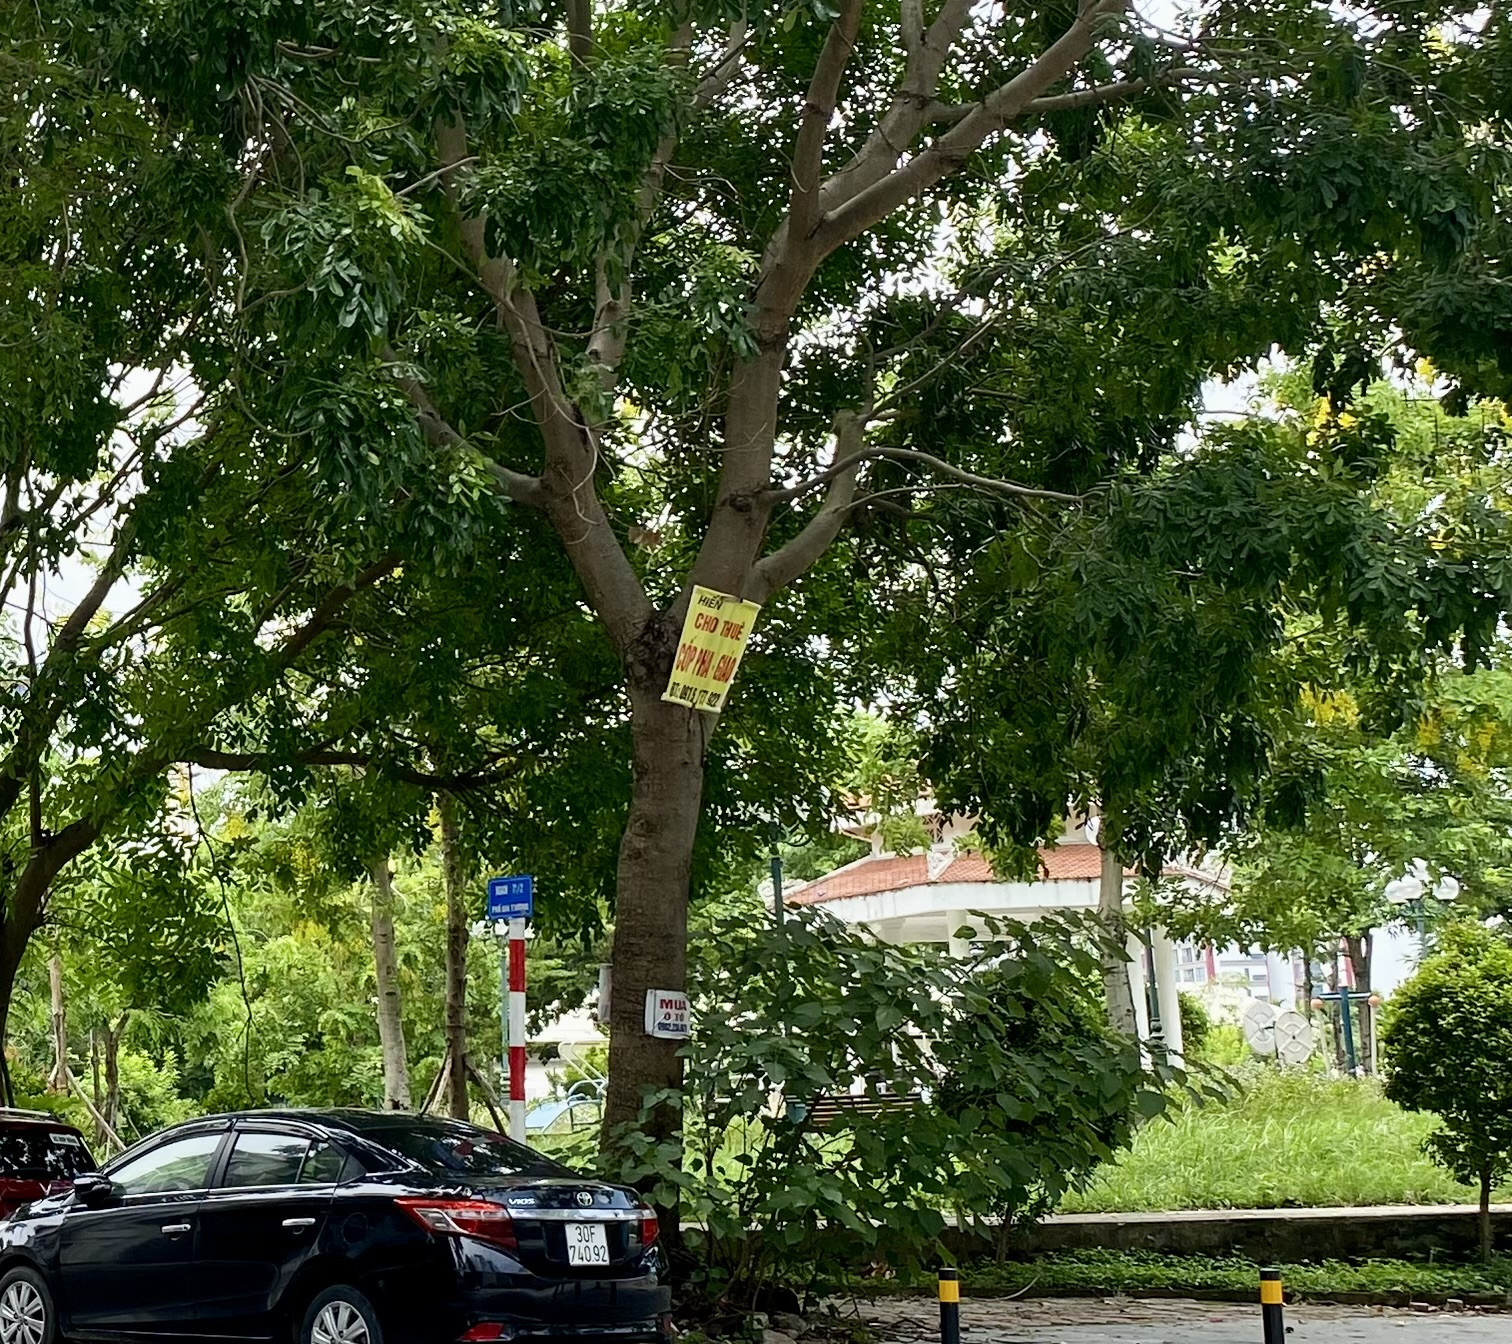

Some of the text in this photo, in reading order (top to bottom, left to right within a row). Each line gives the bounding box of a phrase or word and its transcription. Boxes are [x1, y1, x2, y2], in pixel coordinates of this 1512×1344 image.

[695, 612, 719, 634] CHO
[660, 999, 687, 1010] MUA
[508, 1197, 535, 1205] VIOS
[575, 1225, 595, 1243] 30F
[569, 1245, 607, 1263] 740.92
